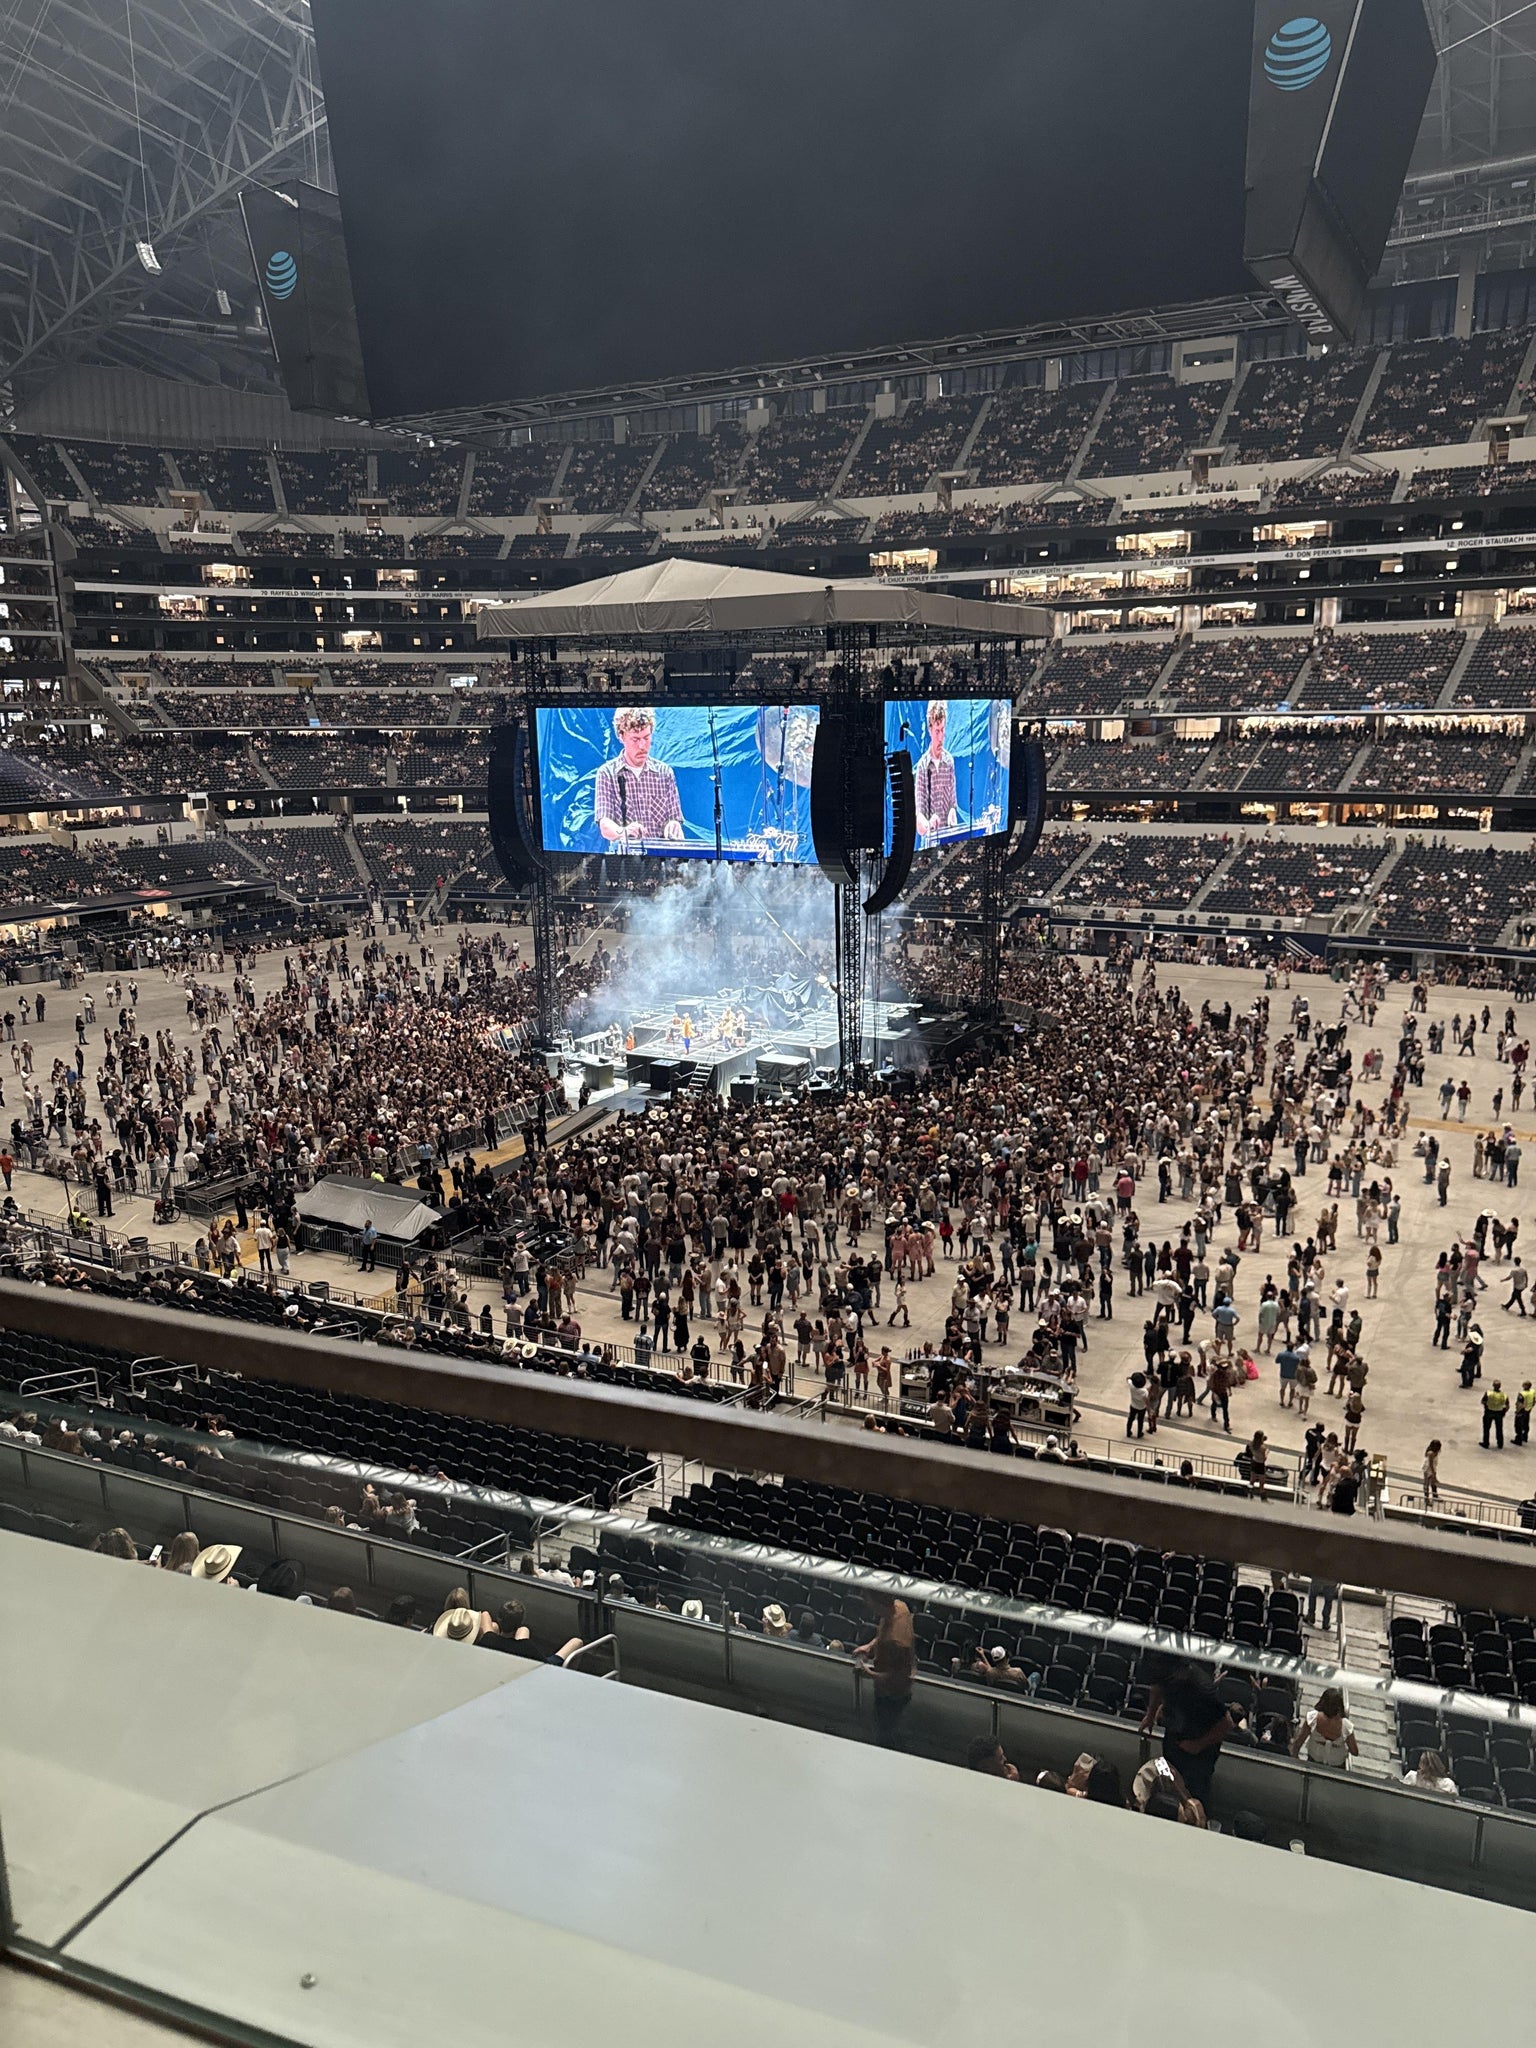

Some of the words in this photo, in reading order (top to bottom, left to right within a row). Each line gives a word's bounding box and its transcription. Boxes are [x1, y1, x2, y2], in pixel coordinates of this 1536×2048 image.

[1269, 274, 1334, 334] WINSTAR
[1458, 539, 1484, 547] ROGER
[1485, 536, 1524, 545] STAUBACH
[1313, 548, 1342, 557] PERKINS
